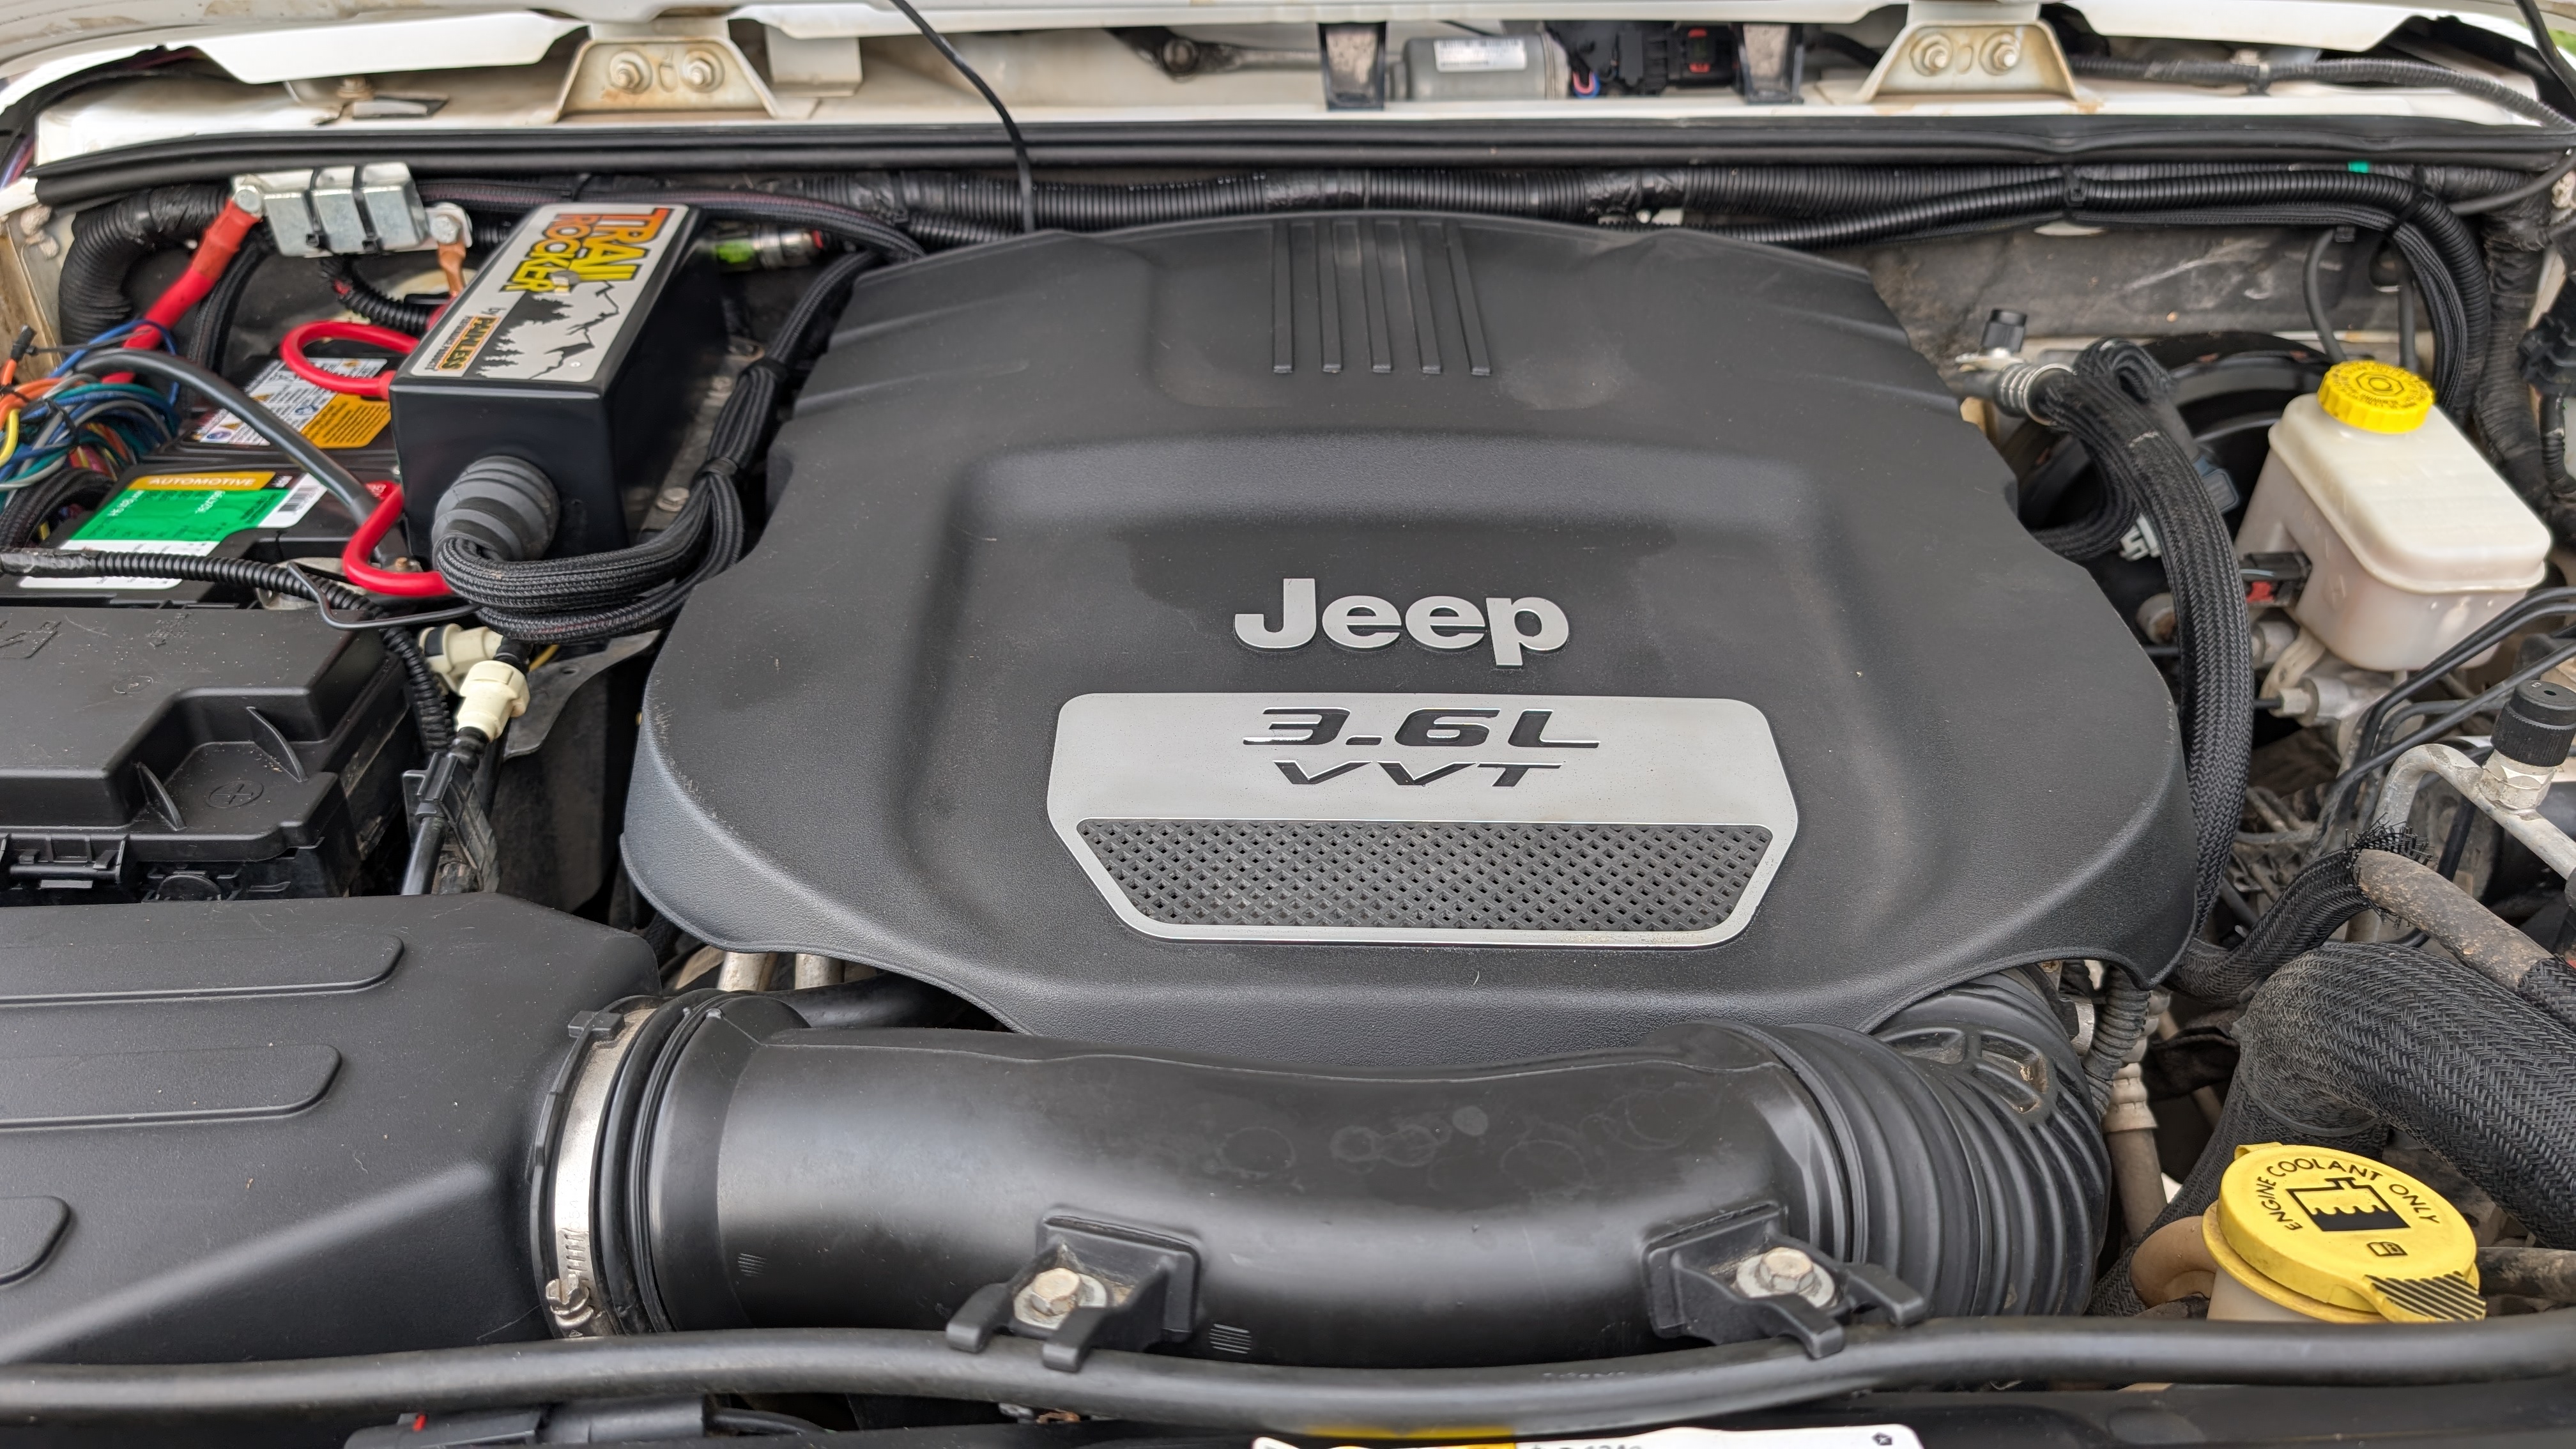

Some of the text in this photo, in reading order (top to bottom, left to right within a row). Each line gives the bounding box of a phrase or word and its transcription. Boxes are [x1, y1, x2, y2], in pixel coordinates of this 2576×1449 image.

[498, 213, 604, 293] ROCKER
[568, 207, 675, 282] TRAIL
[439, 317, 498, 369] PAINLESS
[148, 477, 256, 486] AUTOMOTIVE
[1234, 578, 1570, 669] Jeep
[1243, 707, 1600, 748] 3.6L
[1273, 760, 1563, 787] VVT
[2256, 1158, 2440, 1230] ENGINE COOLANT ONLY
